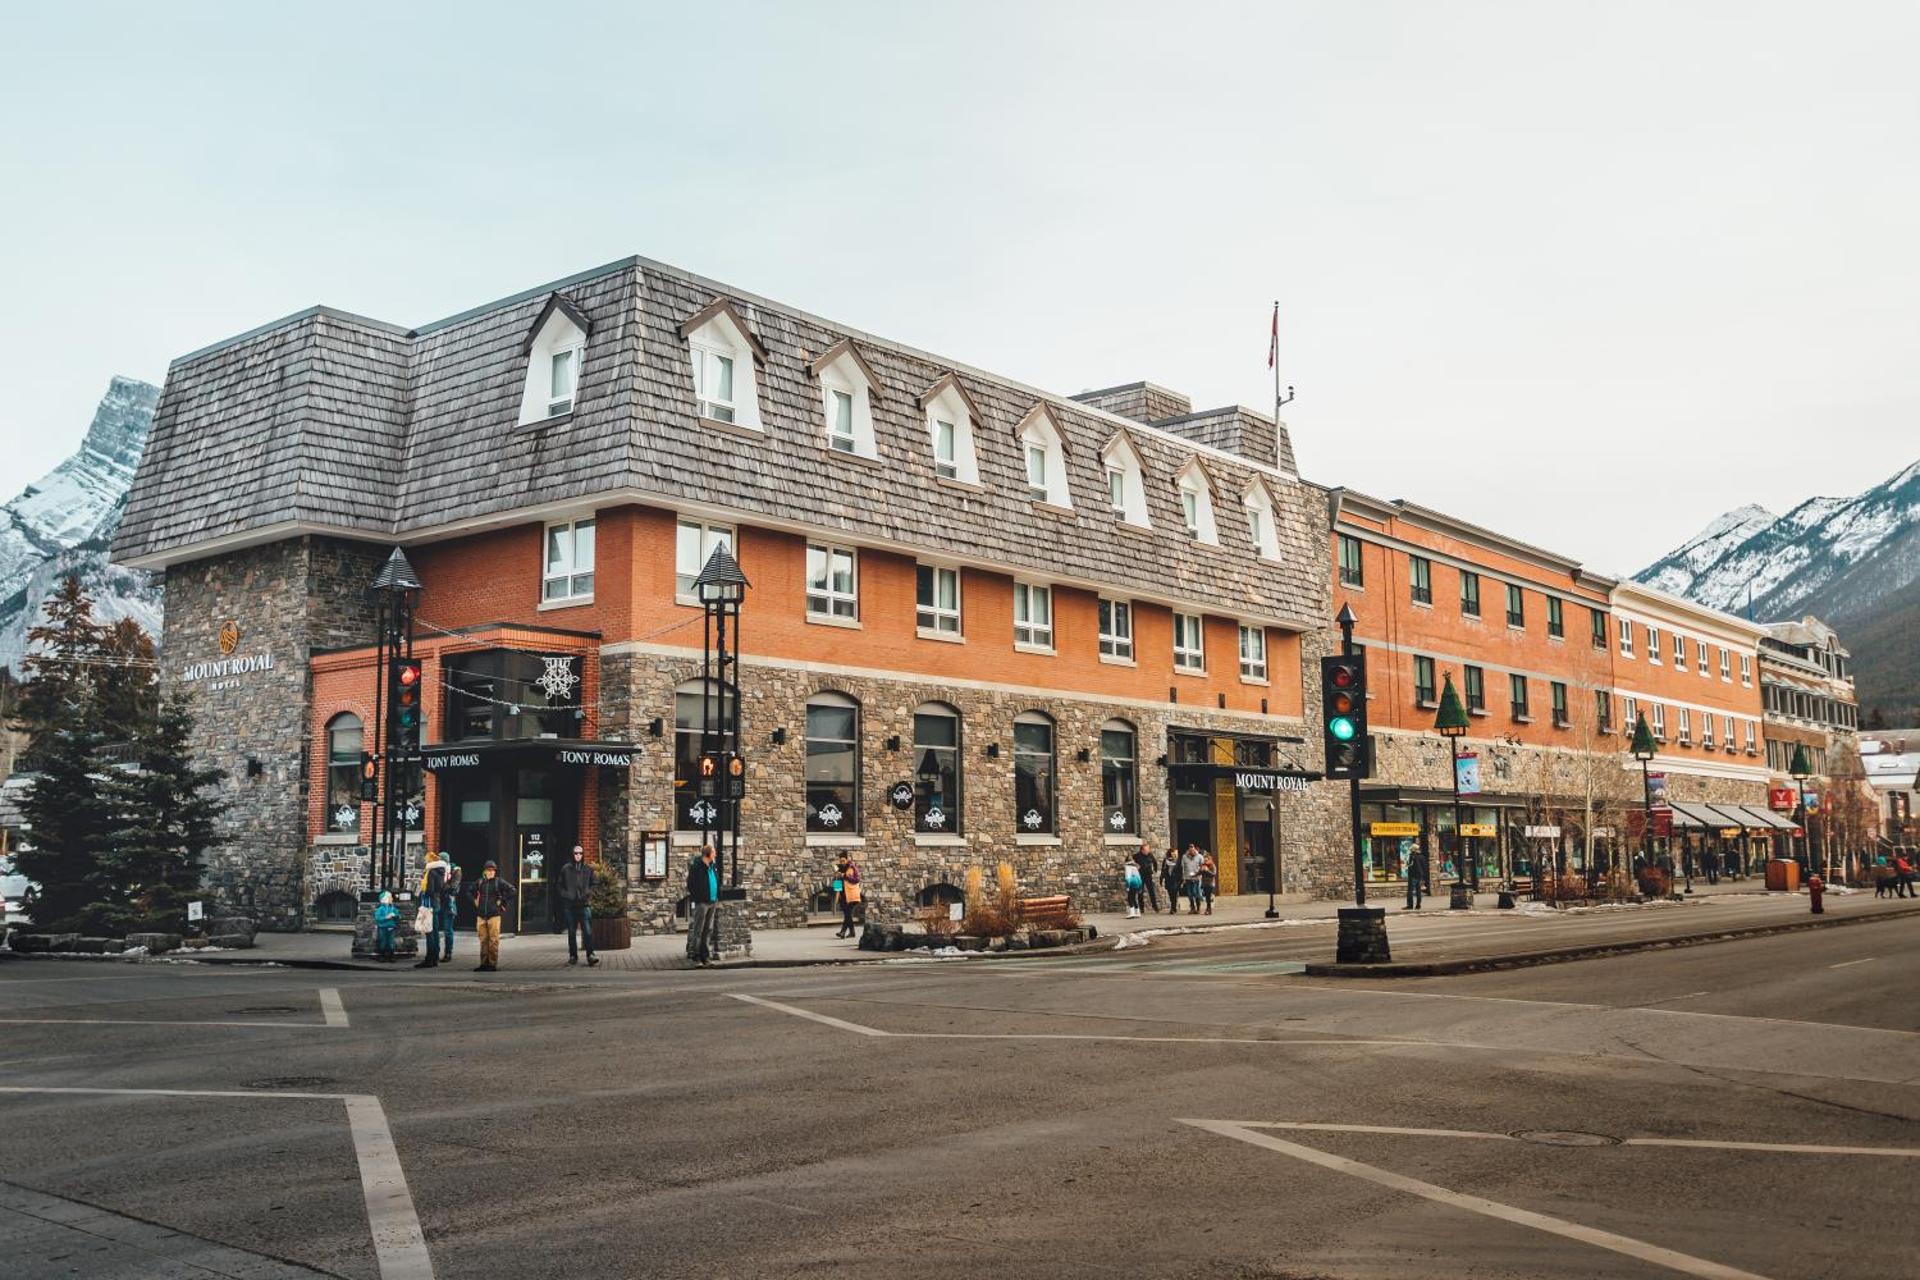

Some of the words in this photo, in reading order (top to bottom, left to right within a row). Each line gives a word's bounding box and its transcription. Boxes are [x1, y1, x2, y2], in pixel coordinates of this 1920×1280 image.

[184, 661, 230, 682] MOUNT
[232, 654, 274, 674] ROYAL
[427, 755, 449, 768] TONY
[561, 751, 591, 764] TONY
[1236, 773, 1275, 789] MOUNT
[1276, 776, 1309, 791] ROYAL
